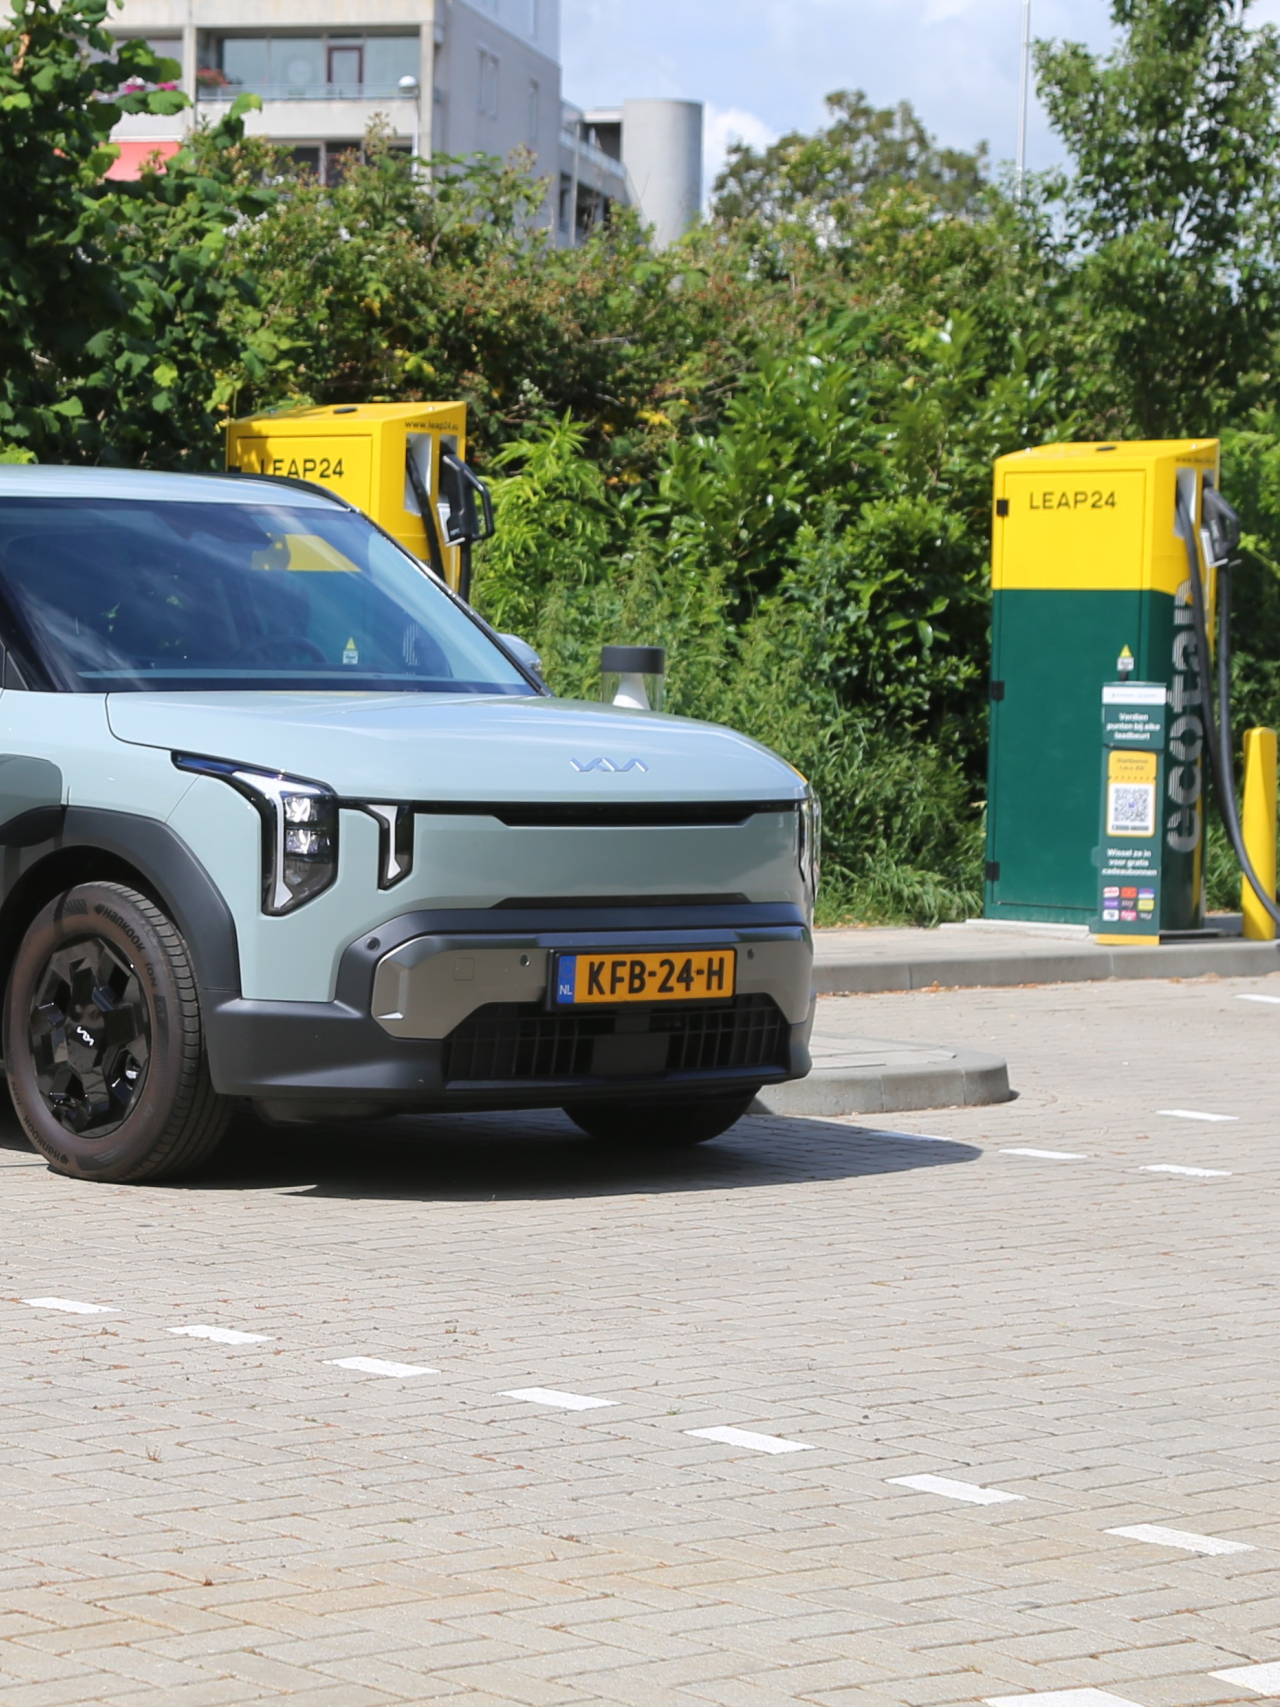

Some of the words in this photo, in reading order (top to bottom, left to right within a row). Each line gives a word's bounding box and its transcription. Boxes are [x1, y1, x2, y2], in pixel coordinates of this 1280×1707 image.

[1029, 490, 1118, 511] LEAP24
[1118, 712, 1149, 721] Verdien
[1106, 722, 1133, 732] punten
[1114, 731, 1151, 740] laadbeurt
[1106, 848, 1132, 857] Wissel
[1143, 849, 1151, 857] in
[1127, 858, 1149, 868] gratis
[1101, 868, 1158, 876] cadeaubonnen
[559, 984, 573, 996] NL
[587, 956, 725, 996] KFB-24-H
